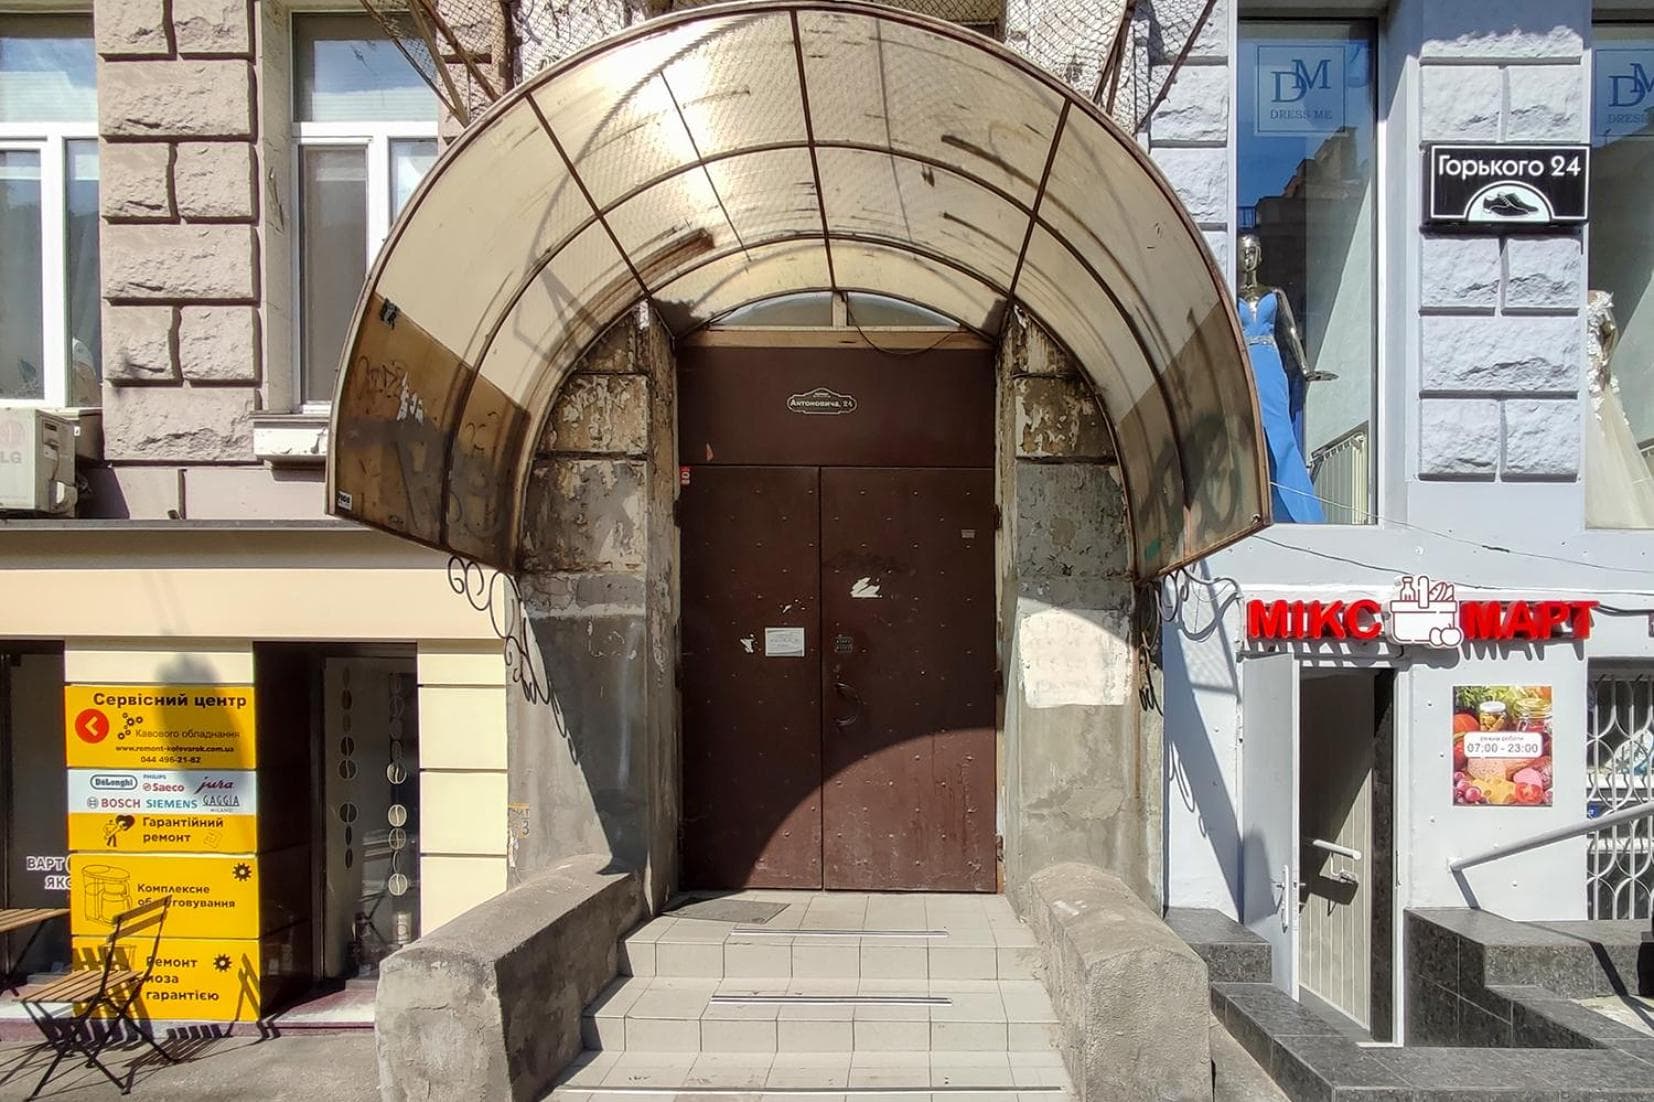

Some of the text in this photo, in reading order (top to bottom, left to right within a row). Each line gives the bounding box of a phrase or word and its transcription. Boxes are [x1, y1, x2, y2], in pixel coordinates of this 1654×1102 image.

[1270, 109, 1310, 120] DRESS
[1438, 155, 1581, 180] Горького 24
[1246, 599, 1599, 641] МІКС МАРТ
[93, 692, 247, 708] Сервісний центр
[135, 729, 240, 738] Кавового обладнання
[1467, 743, 1498, 753] 07:00
[1508, 743, 1538, 753] 23:00
[152, 783, 185, 792] Saeco
[194, 776, 234, 794] jura
[101, 798, 141, 808] BOSCH
[146, 799, 198, 809] SIEMENS
[143, 816, 224, 828] Гарантійний
[143, 832, 191, 843] ремонт
[137, 884, 210, 894] Комплексне
[138, 897, 236, 909] обговування
[146, 989, 219, 1001] гарантією
